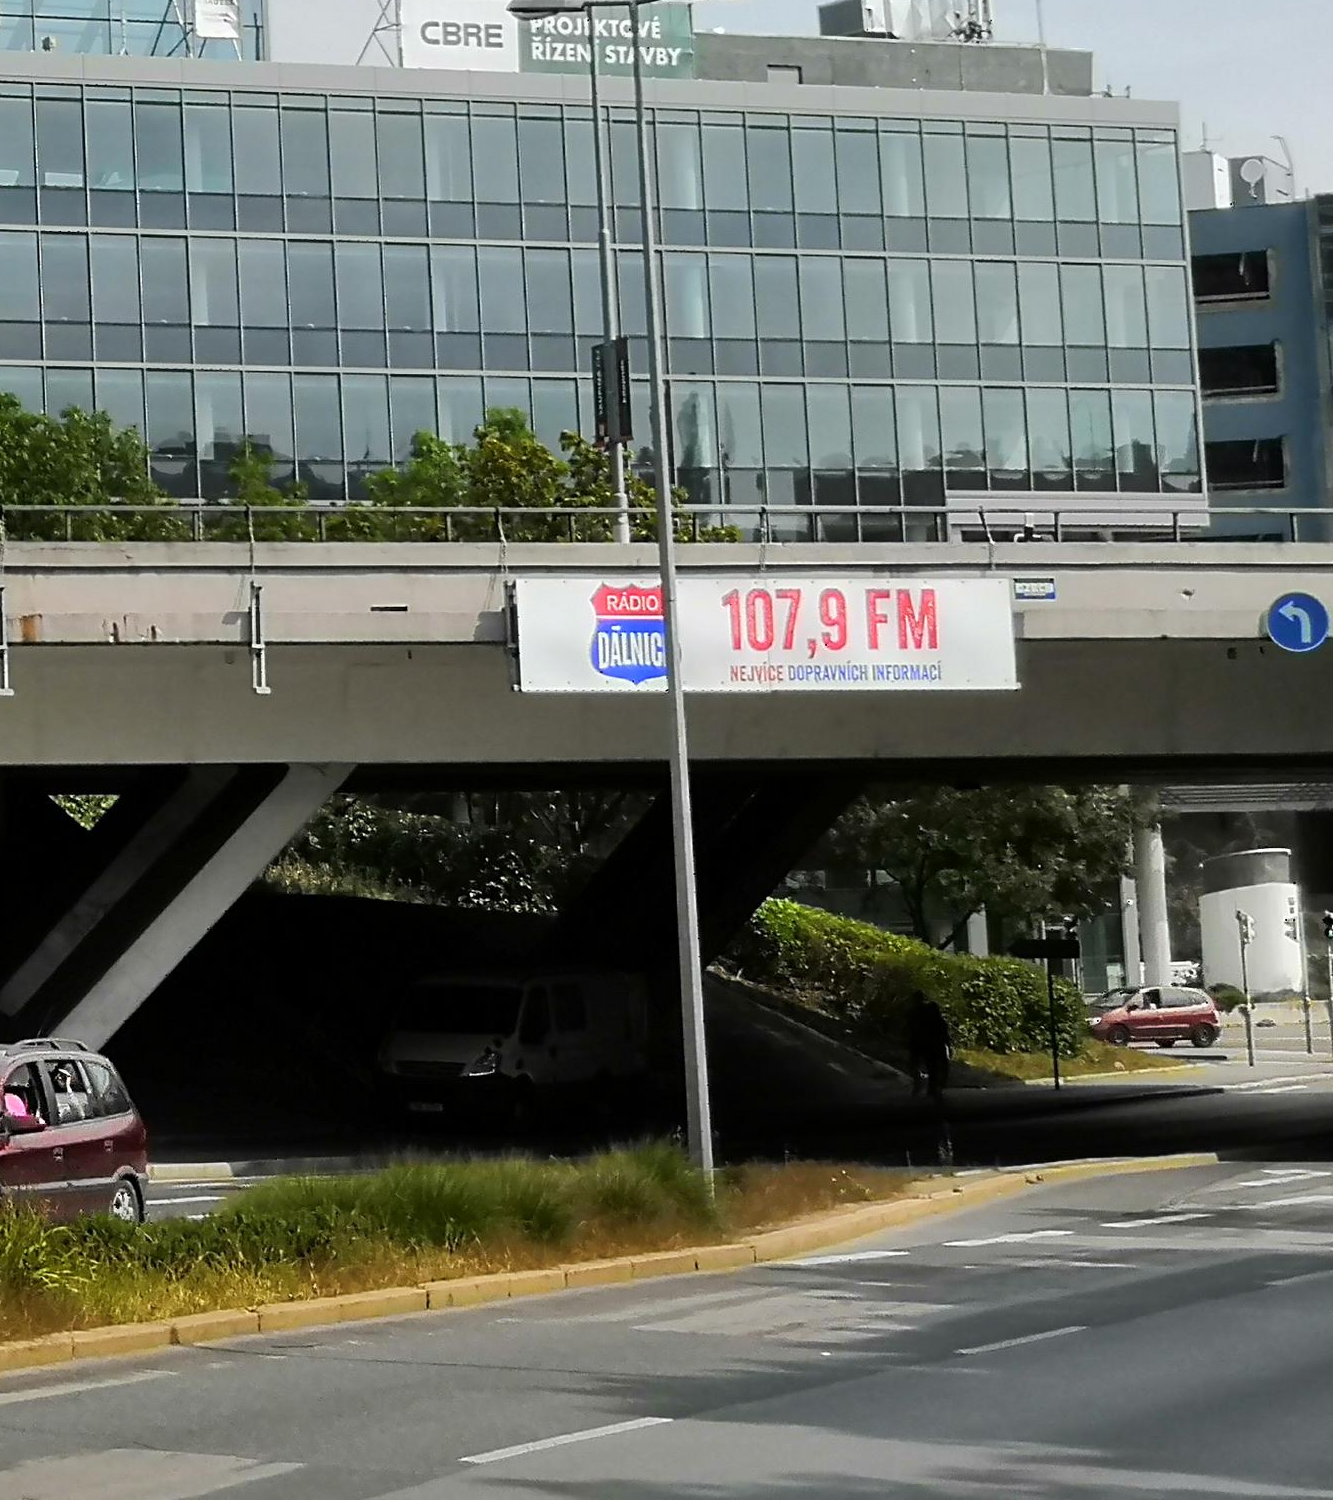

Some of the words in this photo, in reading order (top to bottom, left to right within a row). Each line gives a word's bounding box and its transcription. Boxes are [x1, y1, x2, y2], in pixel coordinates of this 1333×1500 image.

[420, 20, 504, 49] CBRE
[606, 591, 659, 611] RÁDIO
[721, 588, 848, 660] 107,9
[867, 588, 940, 650] FM
[597, 625, 667, 670] DÁLNIC
[729, 662, 784, 683] NEJVÍCE
[787, 661, 869, 683] DOPRAVNÍCH
[872, 661, 943, 683] INFORMACÍ
